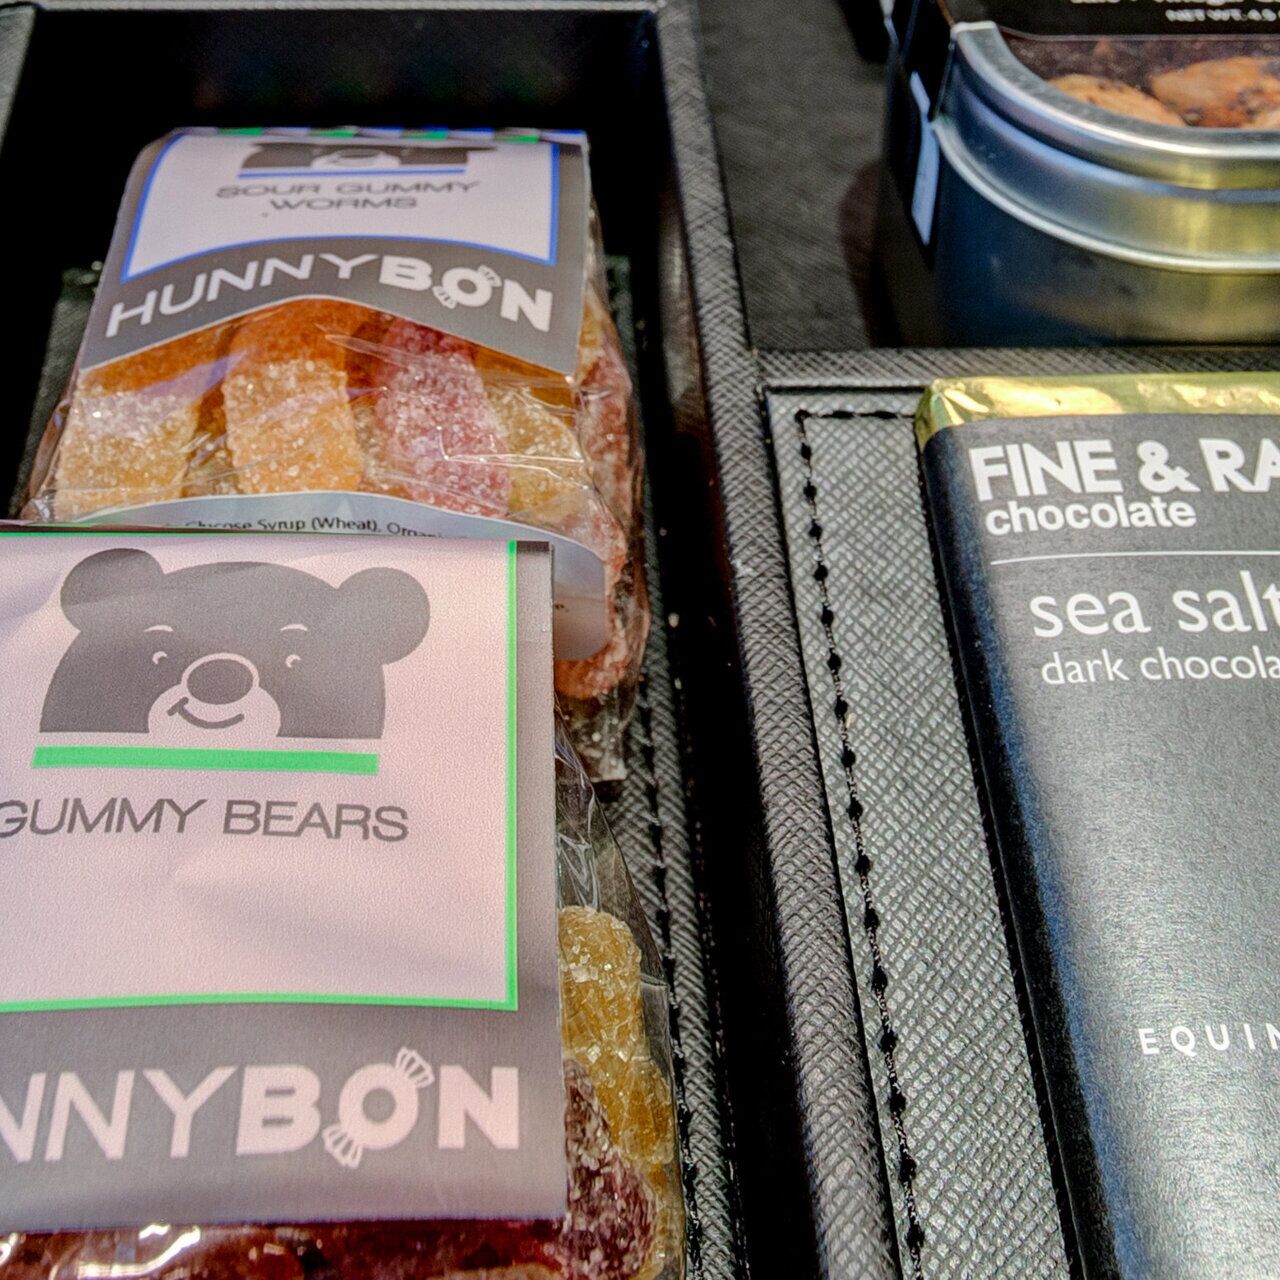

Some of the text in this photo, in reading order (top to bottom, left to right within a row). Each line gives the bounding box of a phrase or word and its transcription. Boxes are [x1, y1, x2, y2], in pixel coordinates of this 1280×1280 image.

[215, 179, 480, 199] SOUR GUMMY
[267, 196, 420, 212] WORMS
[104, 252, 553, 337] HUNNYBON
[968, 437, 1124, 502] FINE
[1135, 440, 1201, 495] &
[984, 496, 1197, 537] chocolate
[1029, 588, 1152, 639] sea
[1040, 648, 1130, 685] dark
[222, 800, 410, 844] BEARS
